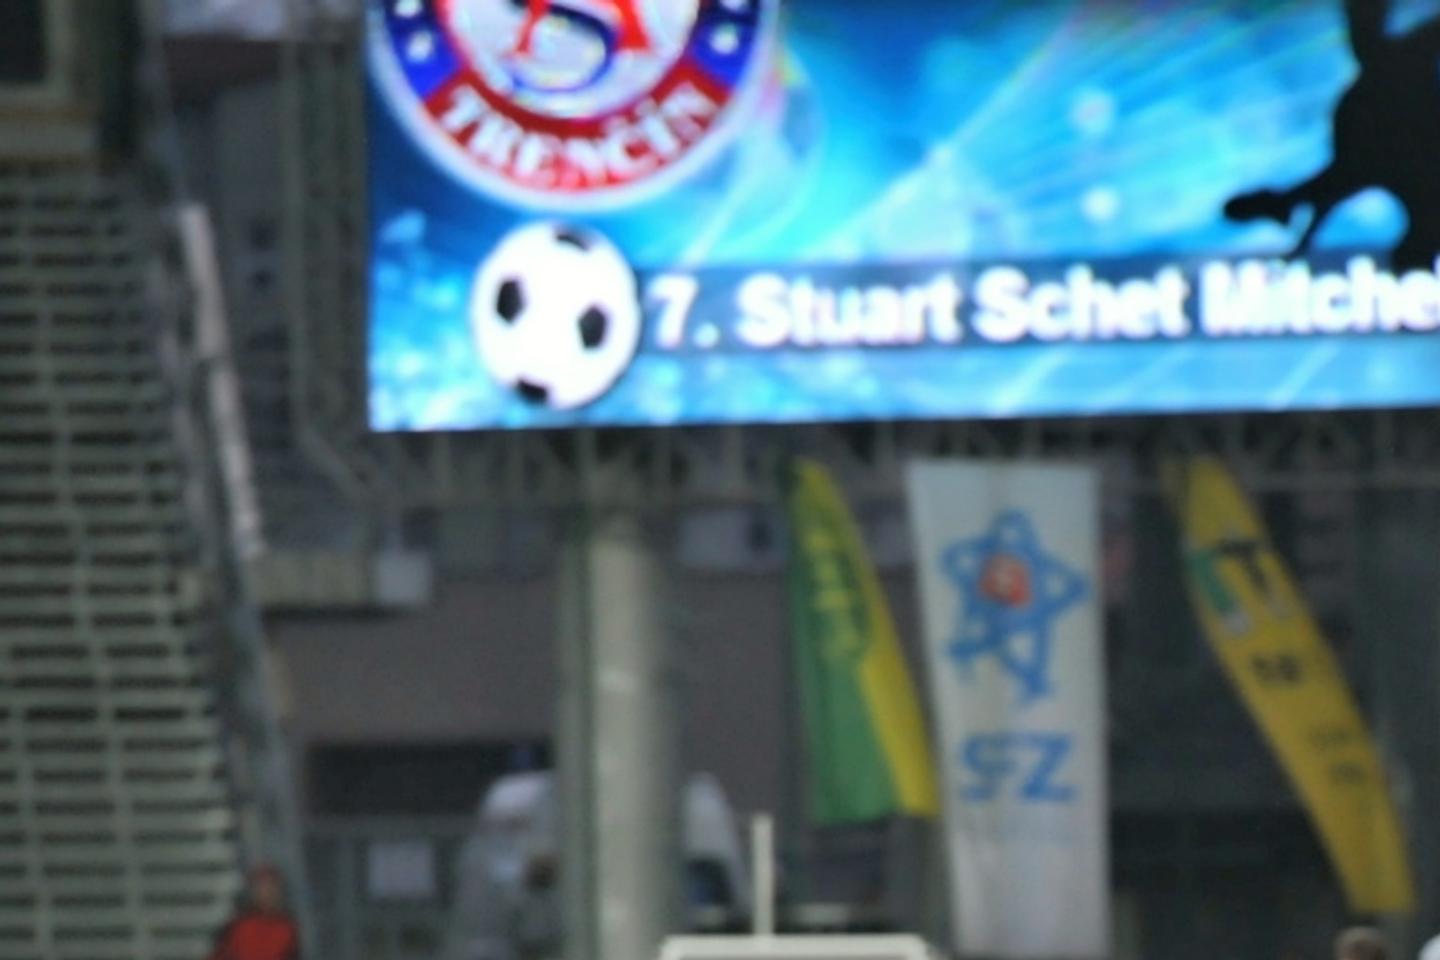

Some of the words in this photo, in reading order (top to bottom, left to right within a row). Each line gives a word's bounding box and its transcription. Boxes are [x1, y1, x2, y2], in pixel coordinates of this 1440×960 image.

[647, 275, 718, 349] 7.
[735, 272, 961, 347] Stuart
[973, 264, 1190, 342] Schet
